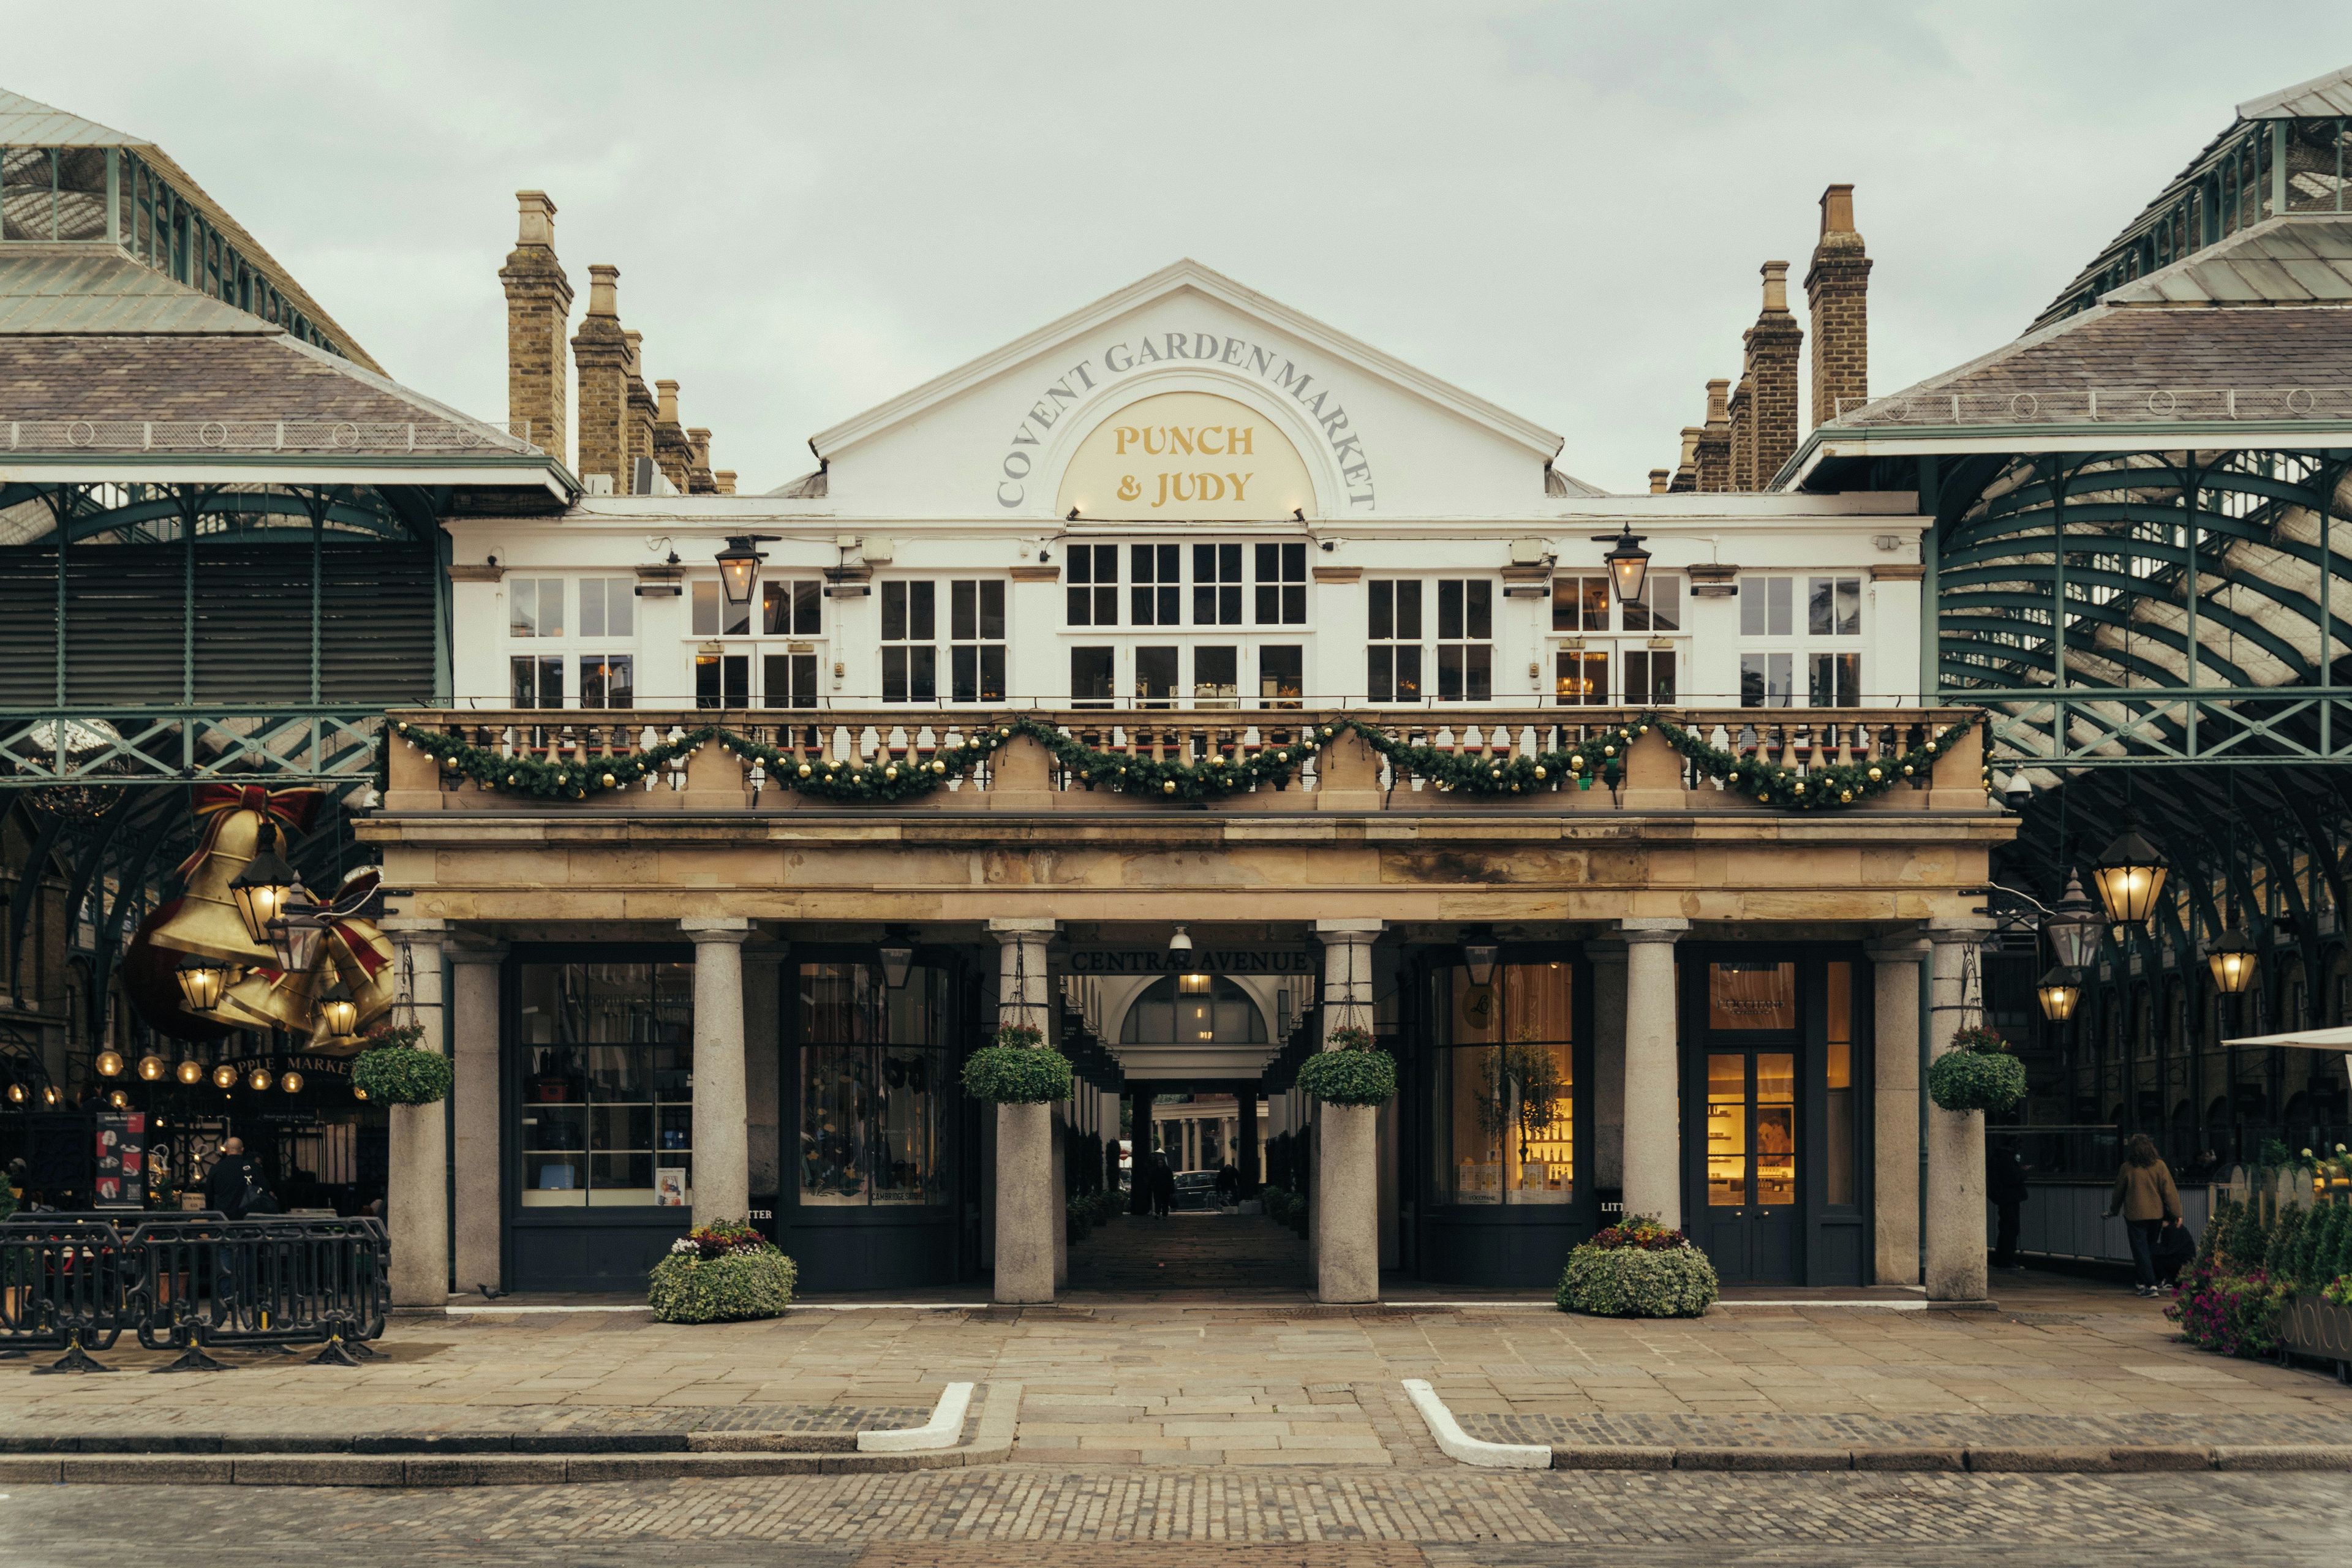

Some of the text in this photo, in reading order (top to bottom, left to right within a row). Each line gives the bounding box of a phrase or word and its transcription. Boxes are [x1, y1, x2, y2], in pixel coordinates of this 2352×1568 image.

[997, 333, 1374, 511] COVENT GARDEN MARKET
[1113, 426, 1254, 456] PUNCH
[1116, 472, 1254, 508] & JUDY
[1198, 951, 1308, 970] AVENUE
[287, 1057, 353, 1076] MARKE
[748, 1210, 772, 1219] TTER
[1601, 1202, 1623, 1212] LITT
